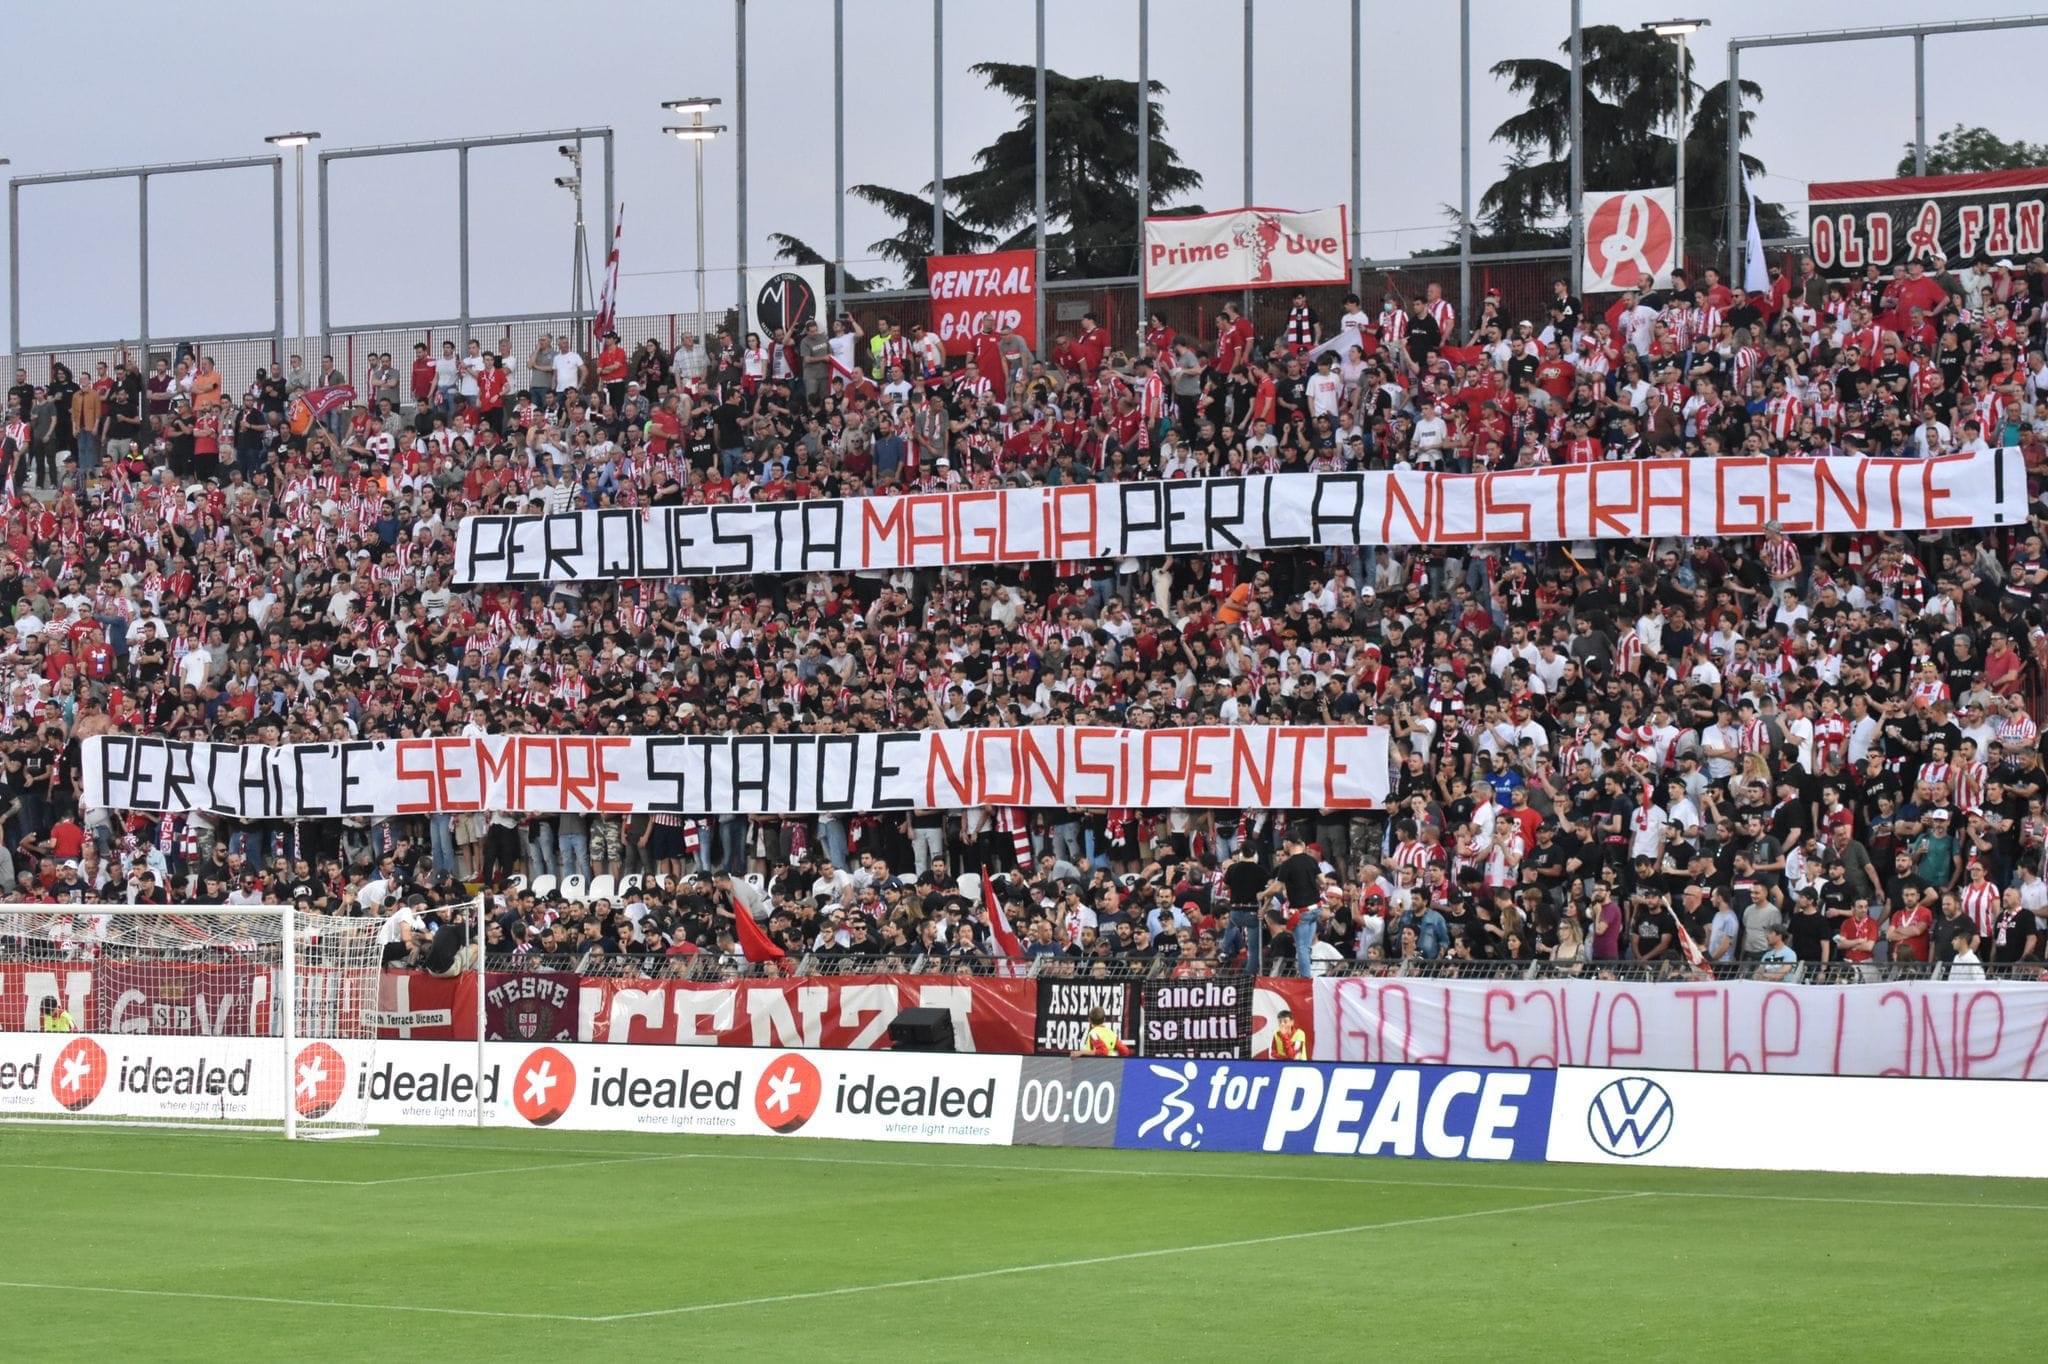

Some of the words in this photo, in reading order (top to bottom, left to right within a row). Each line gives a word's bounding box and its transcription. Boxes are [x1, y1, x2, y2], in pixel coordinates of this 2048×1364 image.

[1151, 242, 1229, 266] Prime
[1286, 234, 1338, 255] Uve
[1812, 213, 1892, 269] OLD
[1959, 200, 2044, 258] FAN
[469, 511, 583, 581] PER
[598, 500, 844, 578] QUESTA
[1120, 478, 1242, 554] PER
[1263, 473, 1364, 545] LA
[1383, 460, 1690, 543] NOSTRA
[101, 736, 195, 810] PER
[397, 737, 633, 813] SEMPRE
[646, 734, 859, 812] STATO
[871, 733, 921, 809] E
[926, 728, 1064, 807] NON
[1142, 727, 1371, 808] PENTE
[488, 976, 569, 1008] TESTE
[1049, 984, 1121, 1015] ASSENZE
[1158, 983, 1236, 1008] anche
[1149, 1020, 1178, 1040] se
[118, 1056, 252, 1096] idealed
[358, 1062, 500, 1104] idealed
[590, 1066, 743, 1110] idealed
[402, 1105, 431, 1116] where
[434, 1106, 455, 1120] light
[835, 1074, 996, 1119] idealed
[1021, 1079, 1115, 1124] 00:00
[1207, 1066, 1270, 1110] for
[1262, 1066, 1532, 1160] PEACE
[637, 1114, 668, 1125] where
[672, 1115, 693, 1128] light
[697, 1117, 736, 1127] matters
[885, 1122, 918, 1133] where
[921, 1123, 945, 1136] light
[948, 1125, 991, 1136] matters
